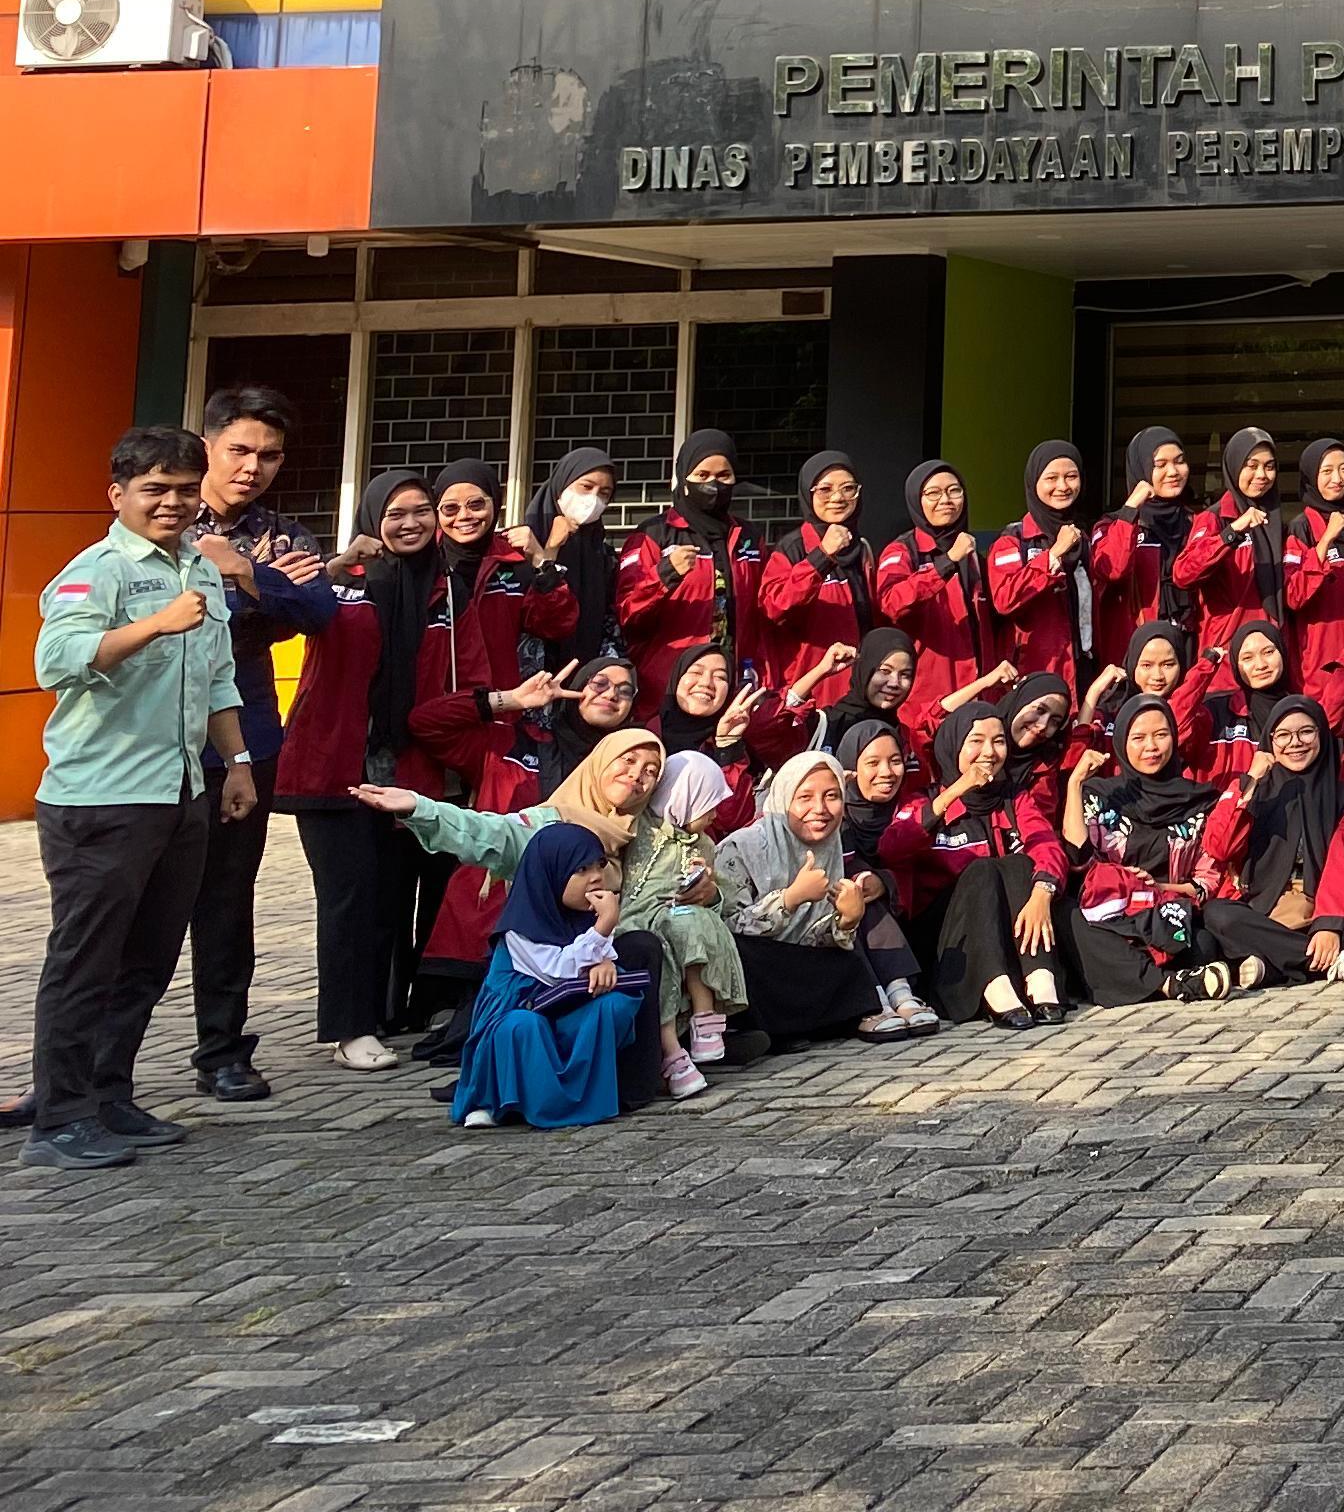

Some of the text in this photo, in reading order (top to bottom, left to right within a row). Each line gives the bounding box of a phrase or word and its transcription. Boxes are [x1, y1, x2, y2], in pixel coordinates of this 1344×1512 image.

[771, 42, 1275, 117] PEMERINTAH
[620, 142, 752, 193] DINAS
[783, 132, 1136, 190] PEMBERDAYAAN
